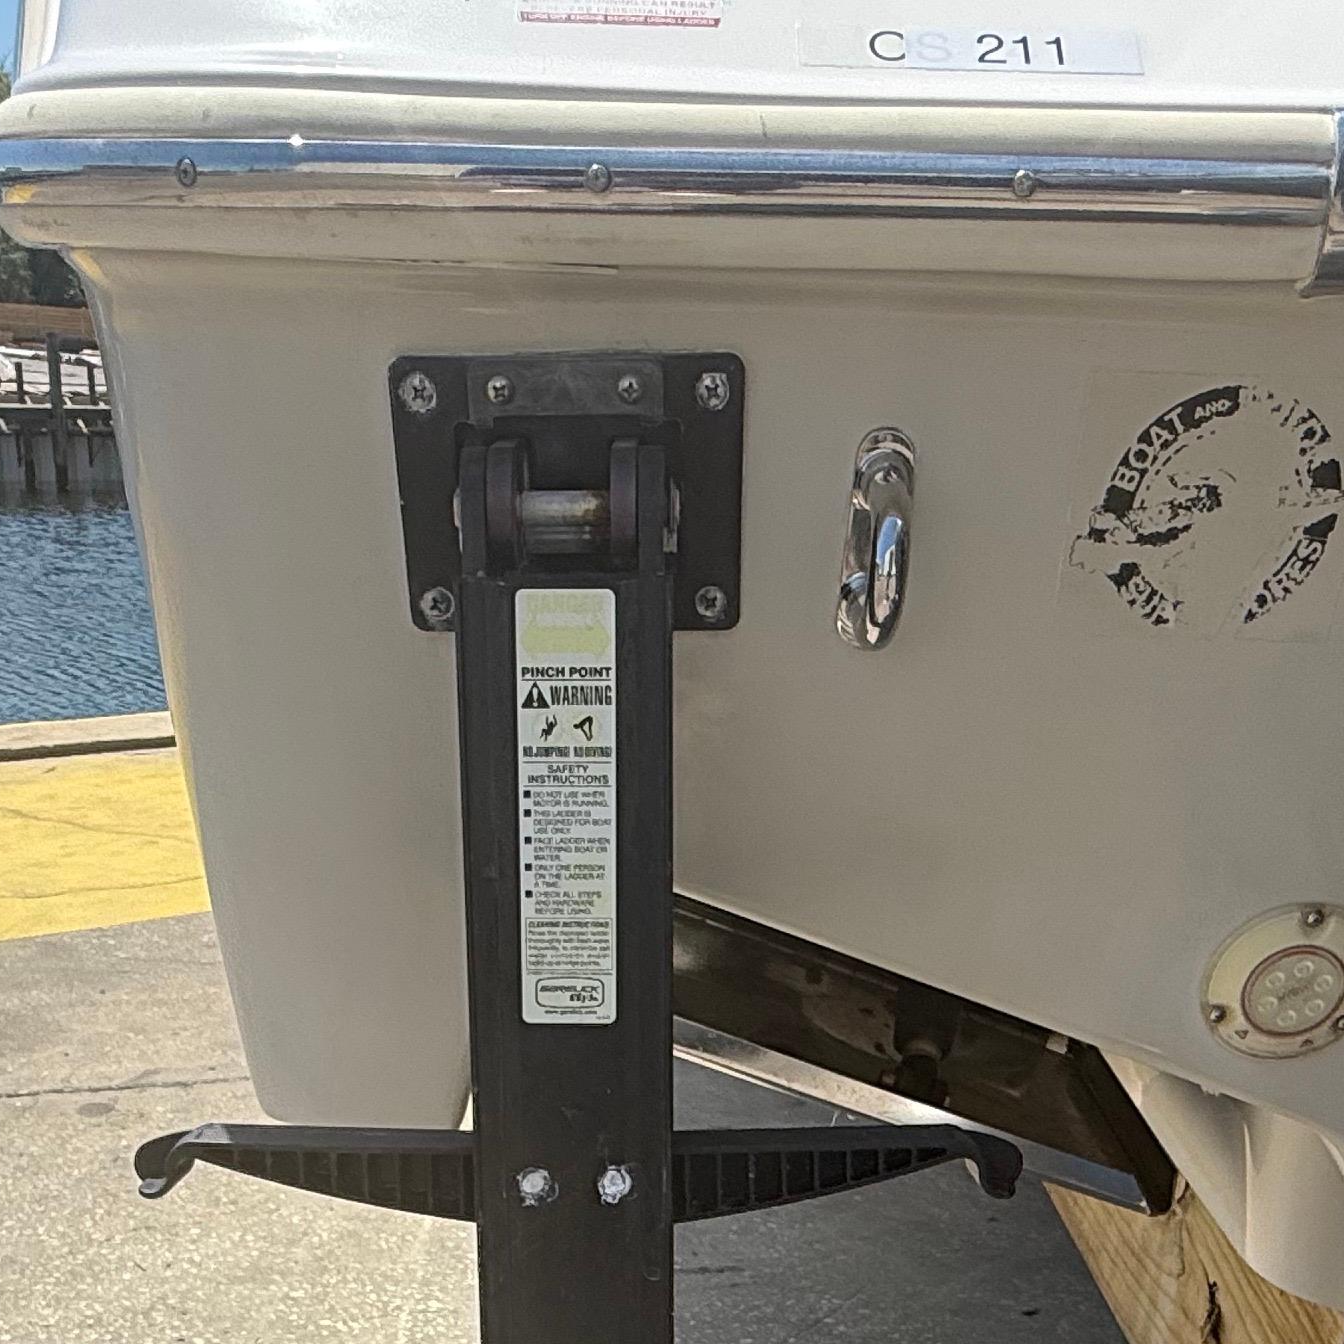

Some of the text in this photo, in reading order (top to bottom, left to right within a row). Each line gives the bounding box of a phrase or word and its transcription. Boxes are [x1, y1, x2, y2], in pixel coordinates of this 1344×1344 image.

[976, 34, 1065, 66] 211
[1111, 405, 1184, 493] BOAT
[1194, 398, 1233, 421] AND
[521, 666, 612, 678] PINCH POINT
[549, 685, 613, 706] WARNING
[547, 764, 589, 774] SAFETY
[528, 774, 609, 785] INSTRUCTIONS
